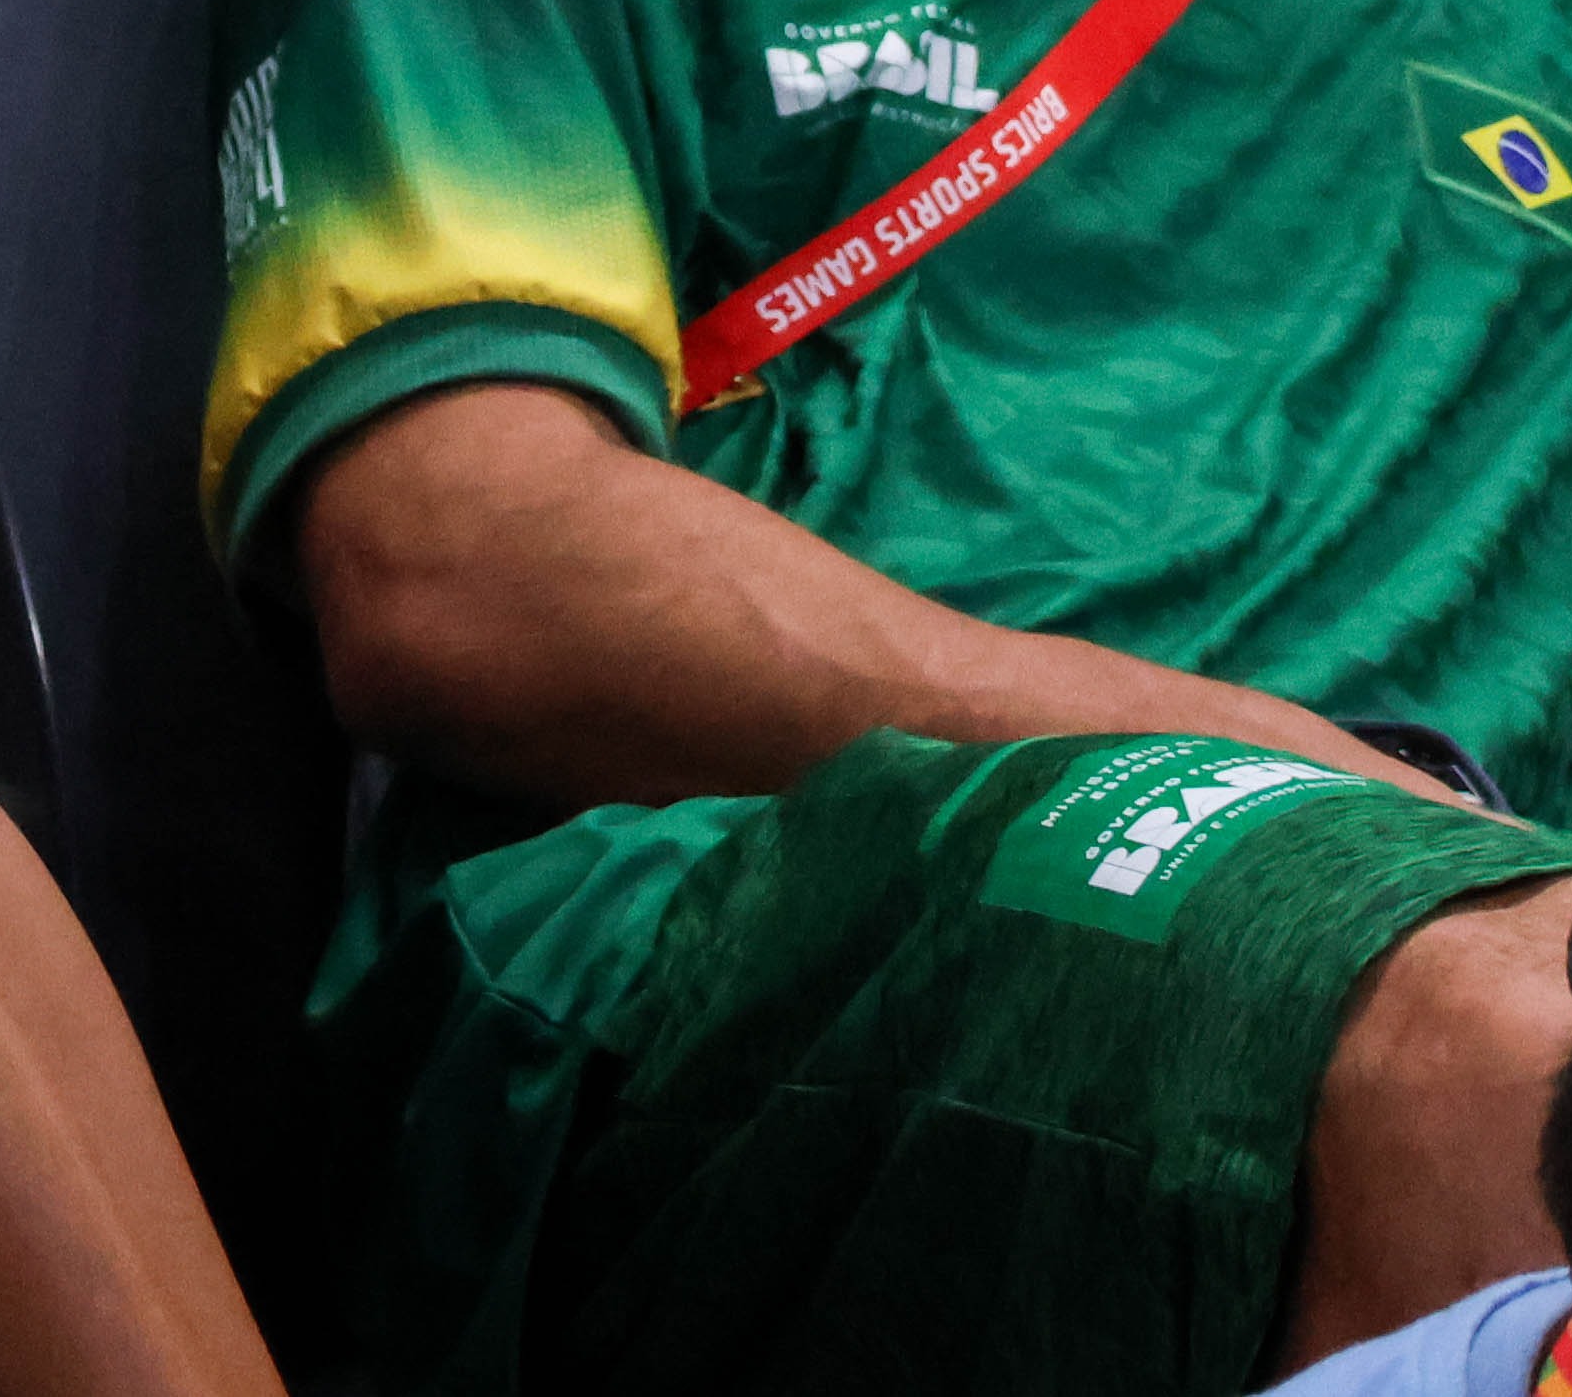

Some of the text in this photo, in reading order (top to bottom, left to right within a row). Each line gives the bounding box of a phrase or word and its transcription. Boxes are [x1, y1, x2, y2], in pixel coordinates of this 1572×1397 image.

[754, 82, 1070, 335] BRICS SPORTS GAMES
[1084, 776, 1183, 861] GOVERNO
